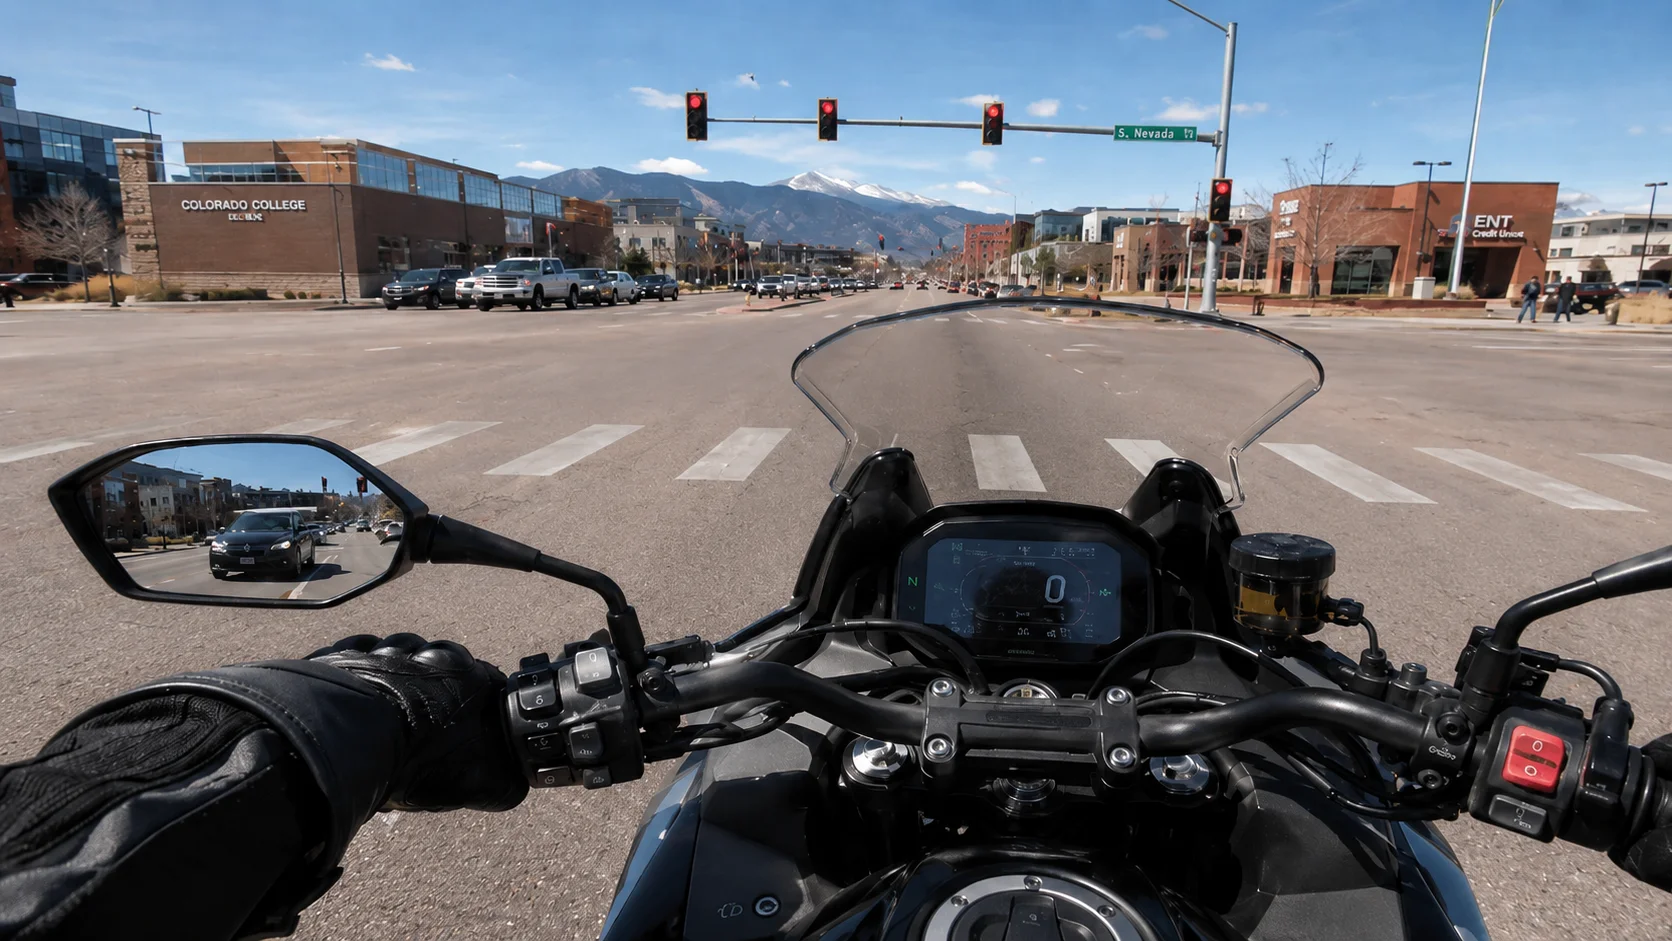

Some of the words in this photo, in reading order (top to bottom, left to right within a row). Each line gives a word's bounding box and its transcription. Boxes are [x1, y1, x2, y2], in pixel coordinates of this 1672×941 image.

[1118, 128, 1129, 138] S.
[1134, 128, 1174, 138] Nevada
[181, 200, 248, 210] COLORADO
[252, 200, 306, 210] COLLEGE
[1474, 215, 1513, 228] ENT
[907, 576, 918, 586] N
[1045, 574, 1066, 604] 0
